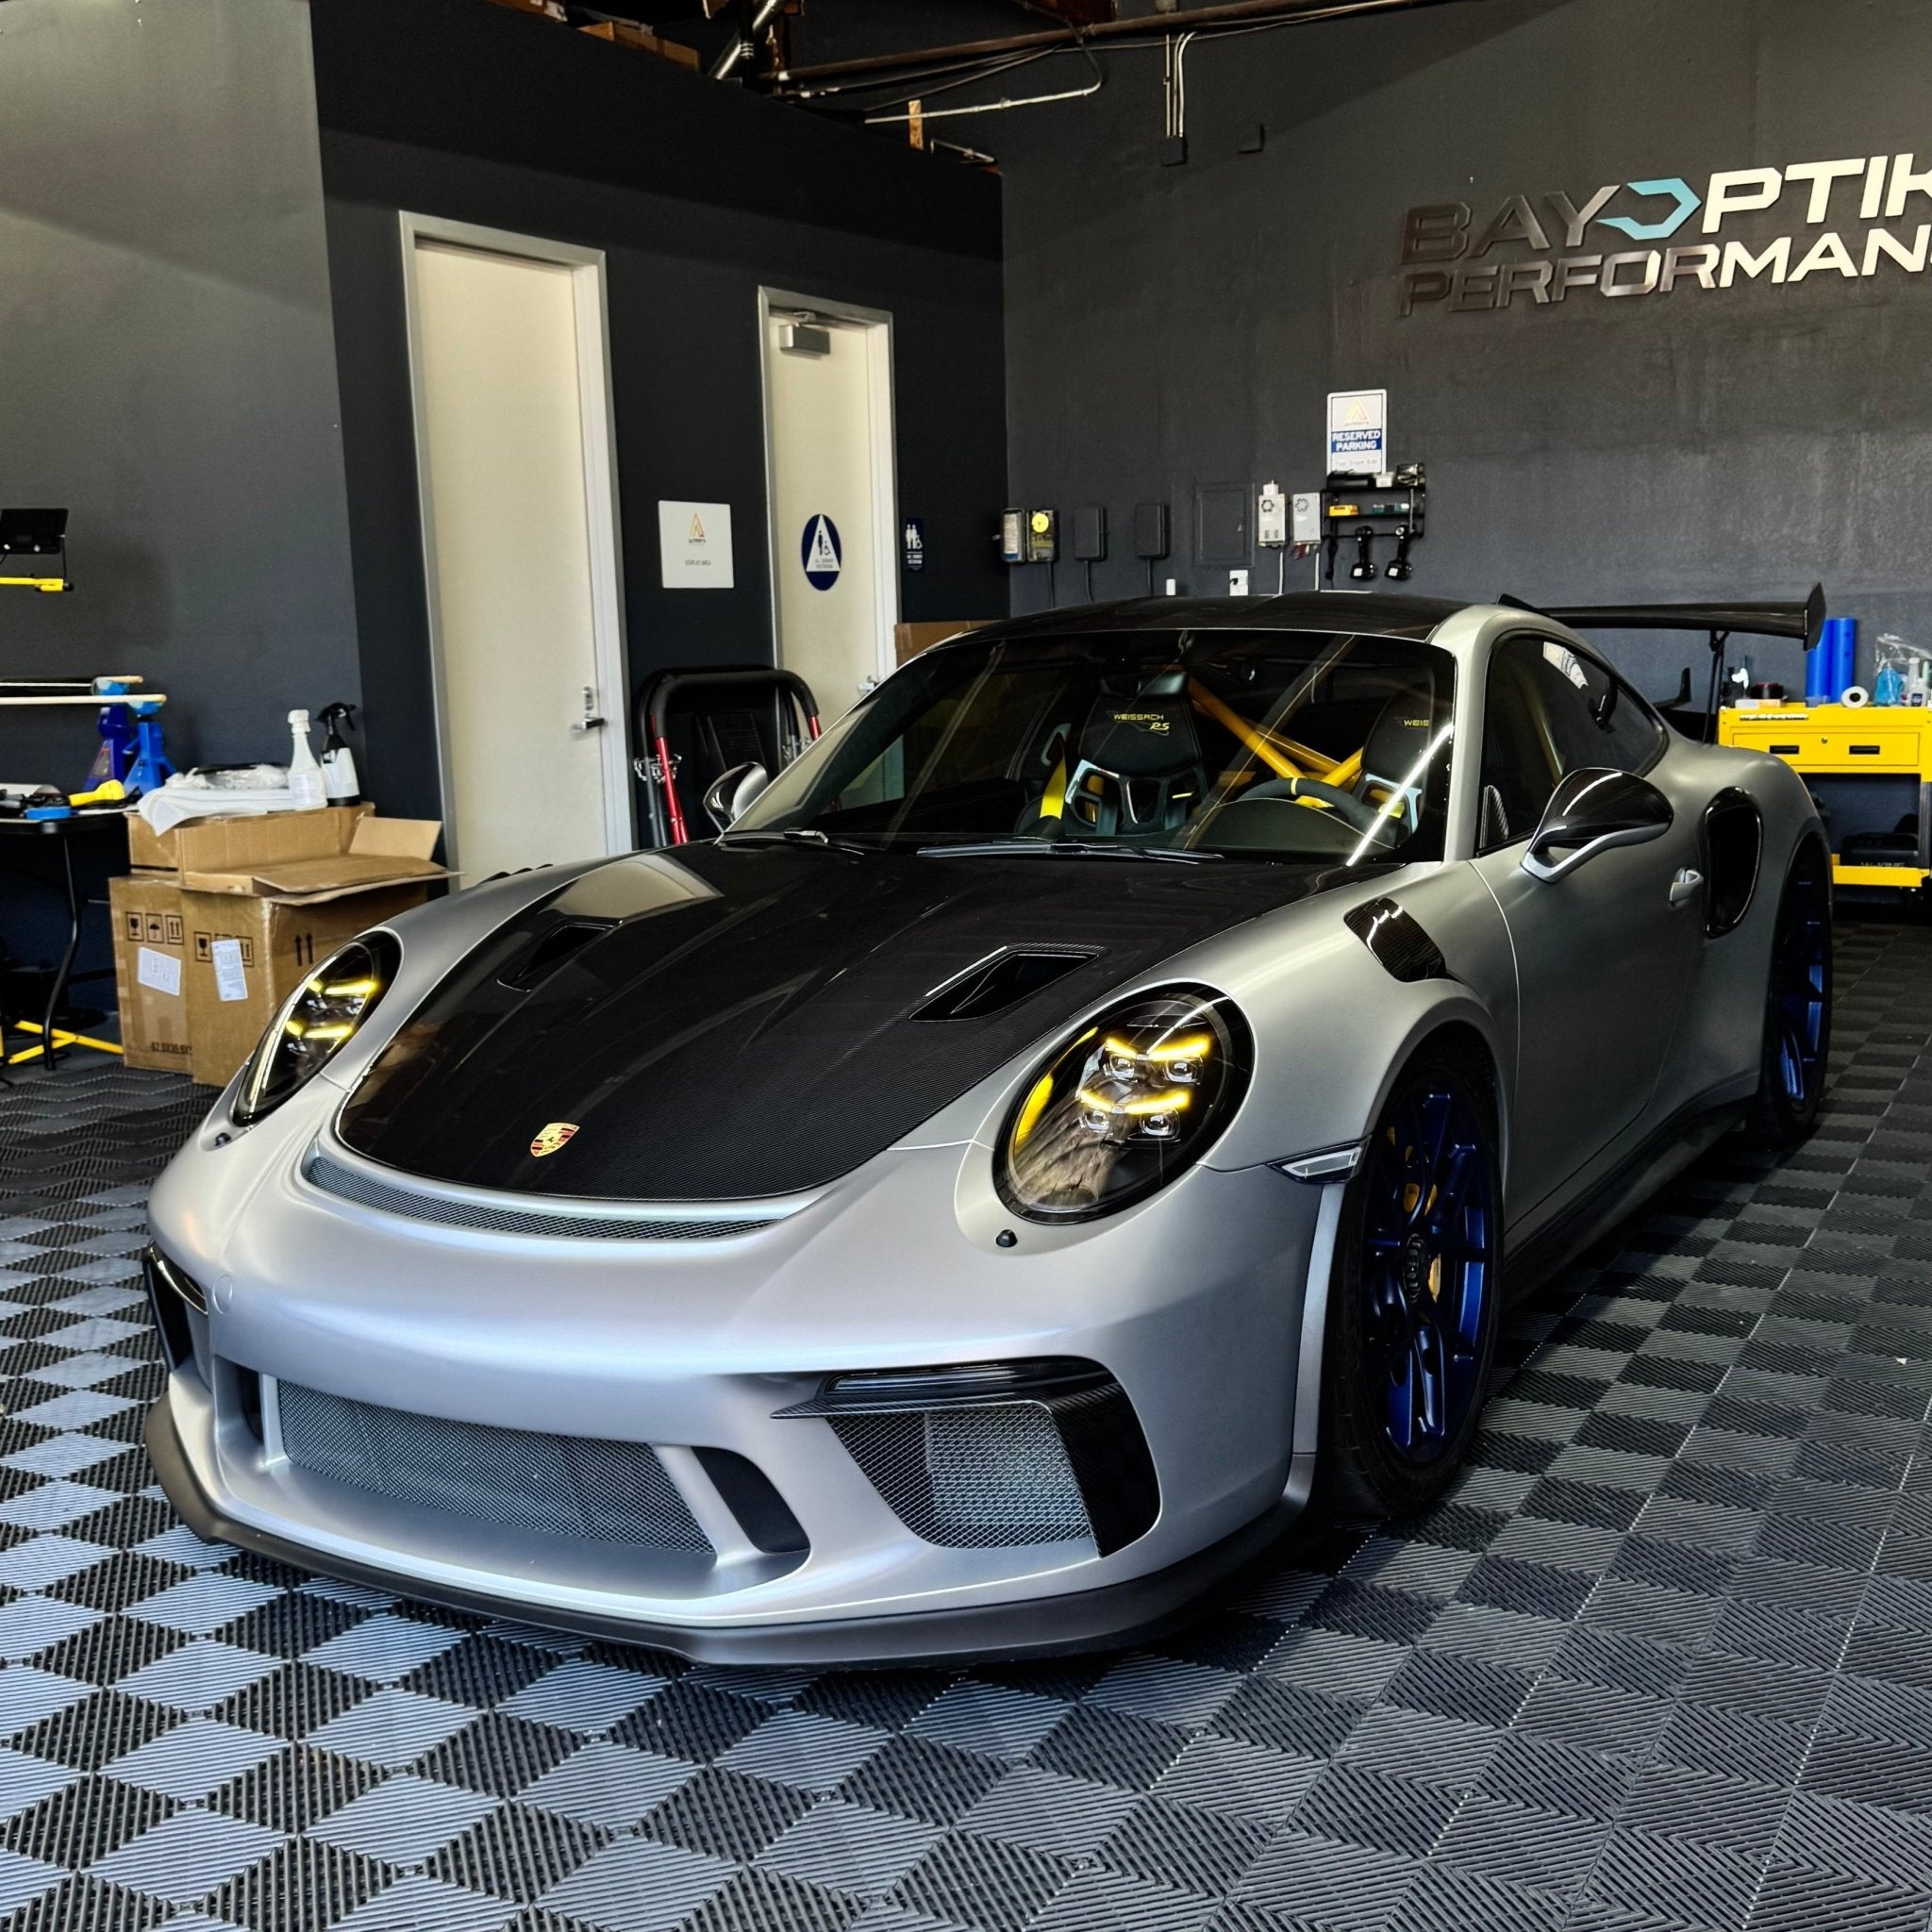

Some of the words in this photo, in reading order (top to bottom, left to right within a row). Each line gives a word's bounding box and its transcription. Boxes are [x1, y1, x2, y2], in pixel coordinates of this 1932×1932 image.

[1399, 224, 1932, 318] PERFORMAN
[1332, 430, 1381, 442] RESERVED
[1336, 441, 1377, 452] PARKING
[1149, 722, 1171, 731] RS
